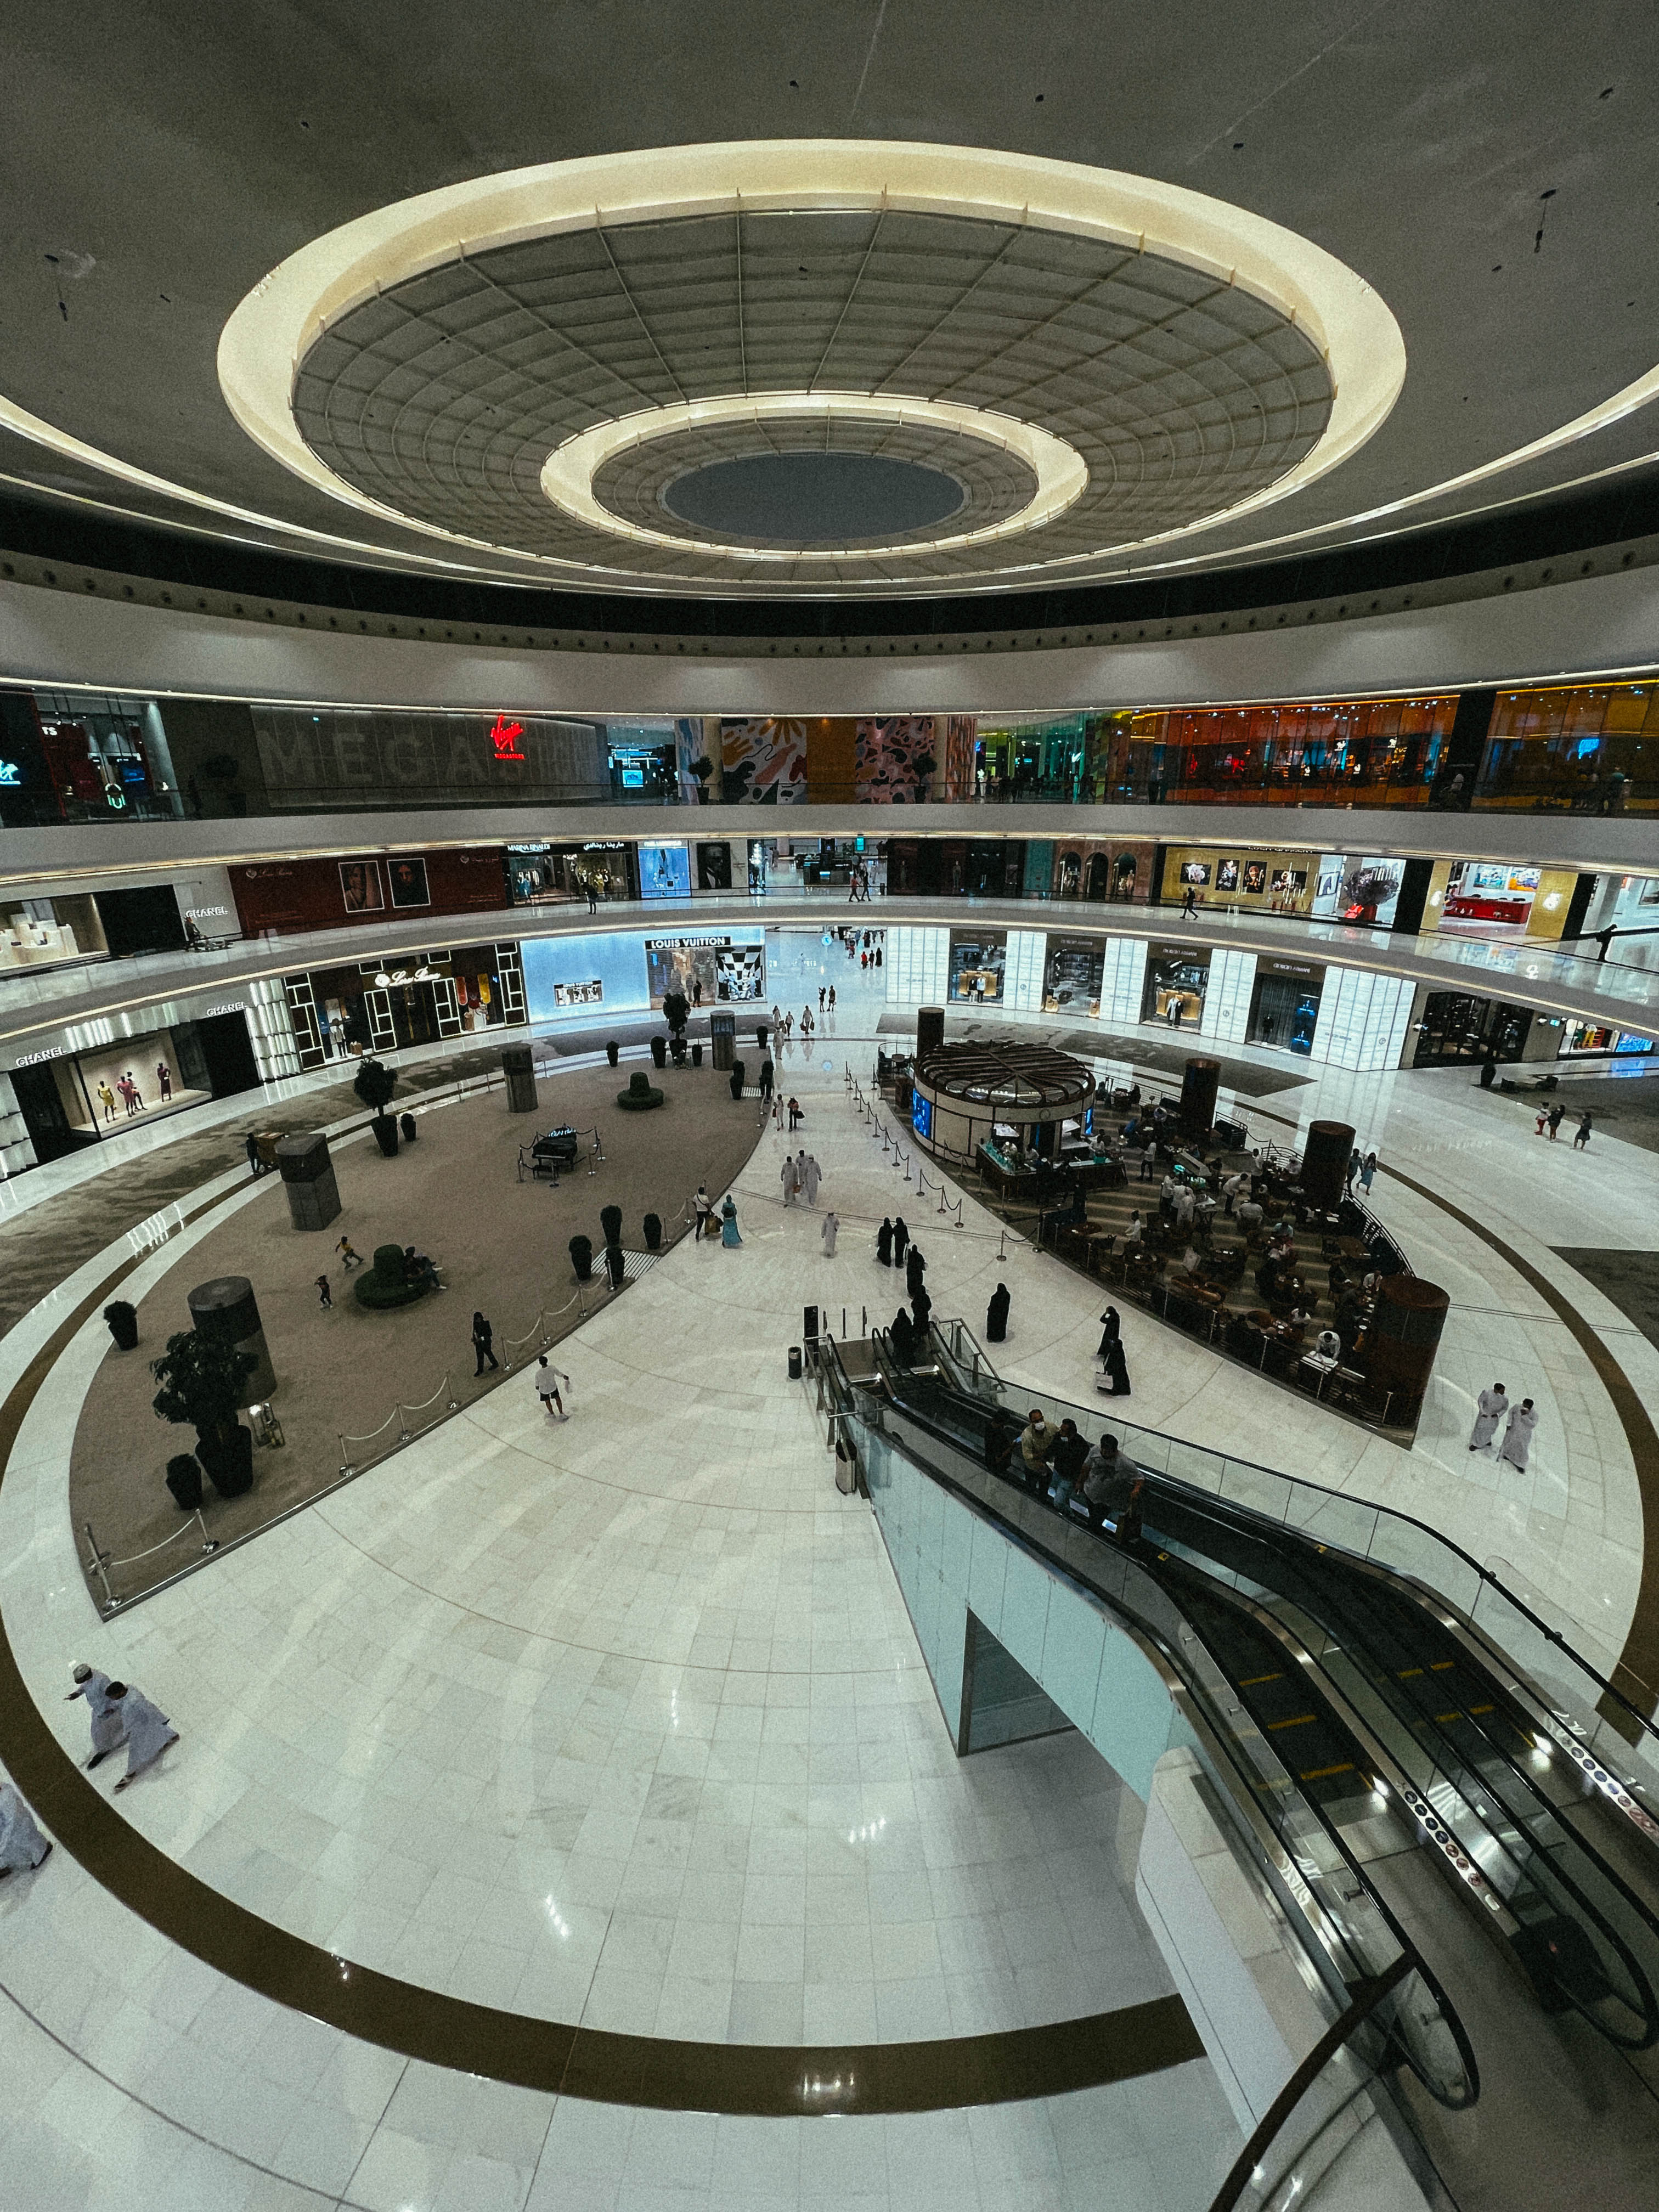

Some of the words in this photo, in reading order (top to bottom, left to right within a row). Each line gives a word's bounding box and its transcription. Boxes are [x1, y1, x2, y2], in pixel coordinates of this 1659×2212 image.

[490, 714, 524, 752] Virgin
[185, 906, 228, 918] CHANEL
[651, 940, 681, 949] LOUIS
[682, 937, 725, 947] VUITTON
[206, 1001, 249, 1017] CHANEL
[15, 1046, 67, 1068] CHANEL
